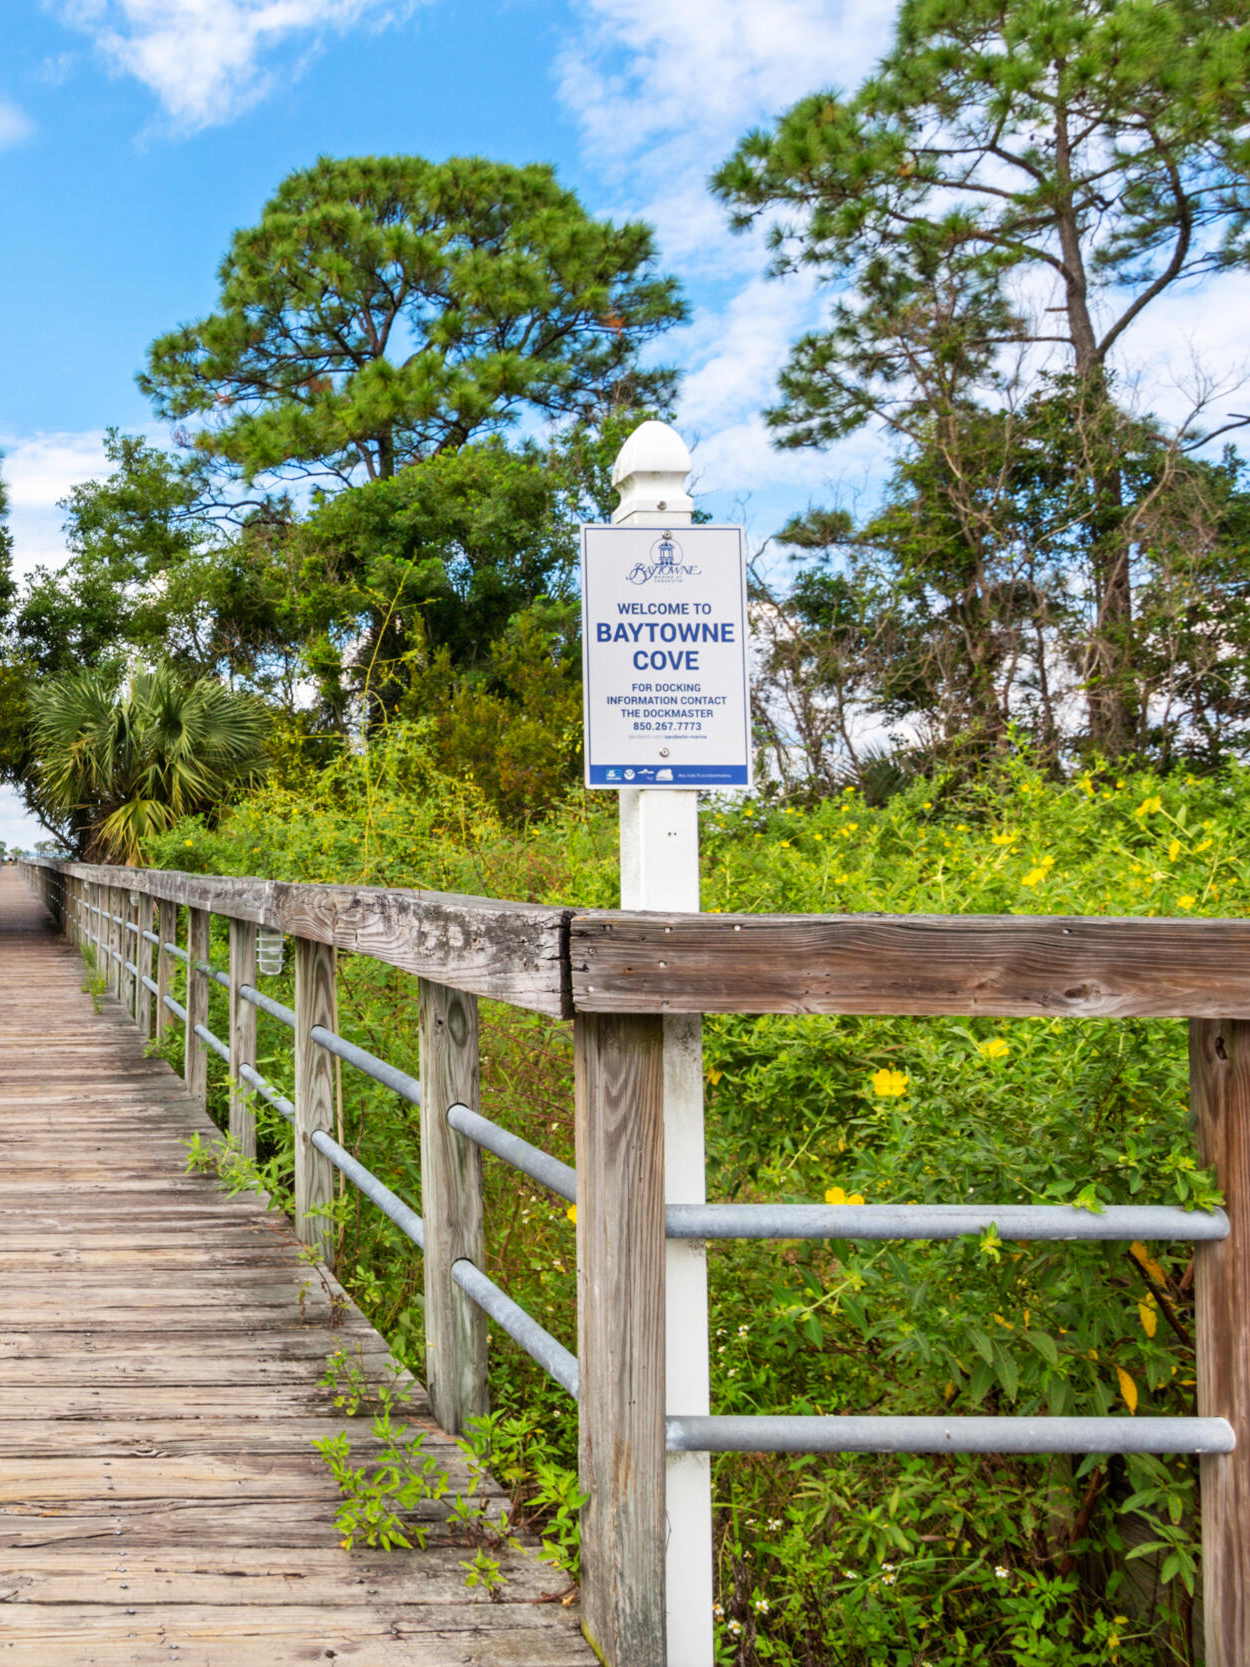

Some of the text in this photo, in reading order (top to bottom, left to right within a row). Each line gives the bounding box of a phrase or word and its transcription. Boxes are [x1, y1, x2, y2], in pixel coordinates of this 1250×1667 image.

[617, 603, 712, 615] WELCOME TO
[596, 623, 735, 643] BAYTOWNE
[633, 650, 699, 671] COVE
[631, 683, 701, 692] FOR DOCKING
[606, 696, 727, 705] INFORMATION CONTACT
[621, 709, 714, 718] THE DOCKMASTER
[633, 722, 702, 731] 850.267.7773
